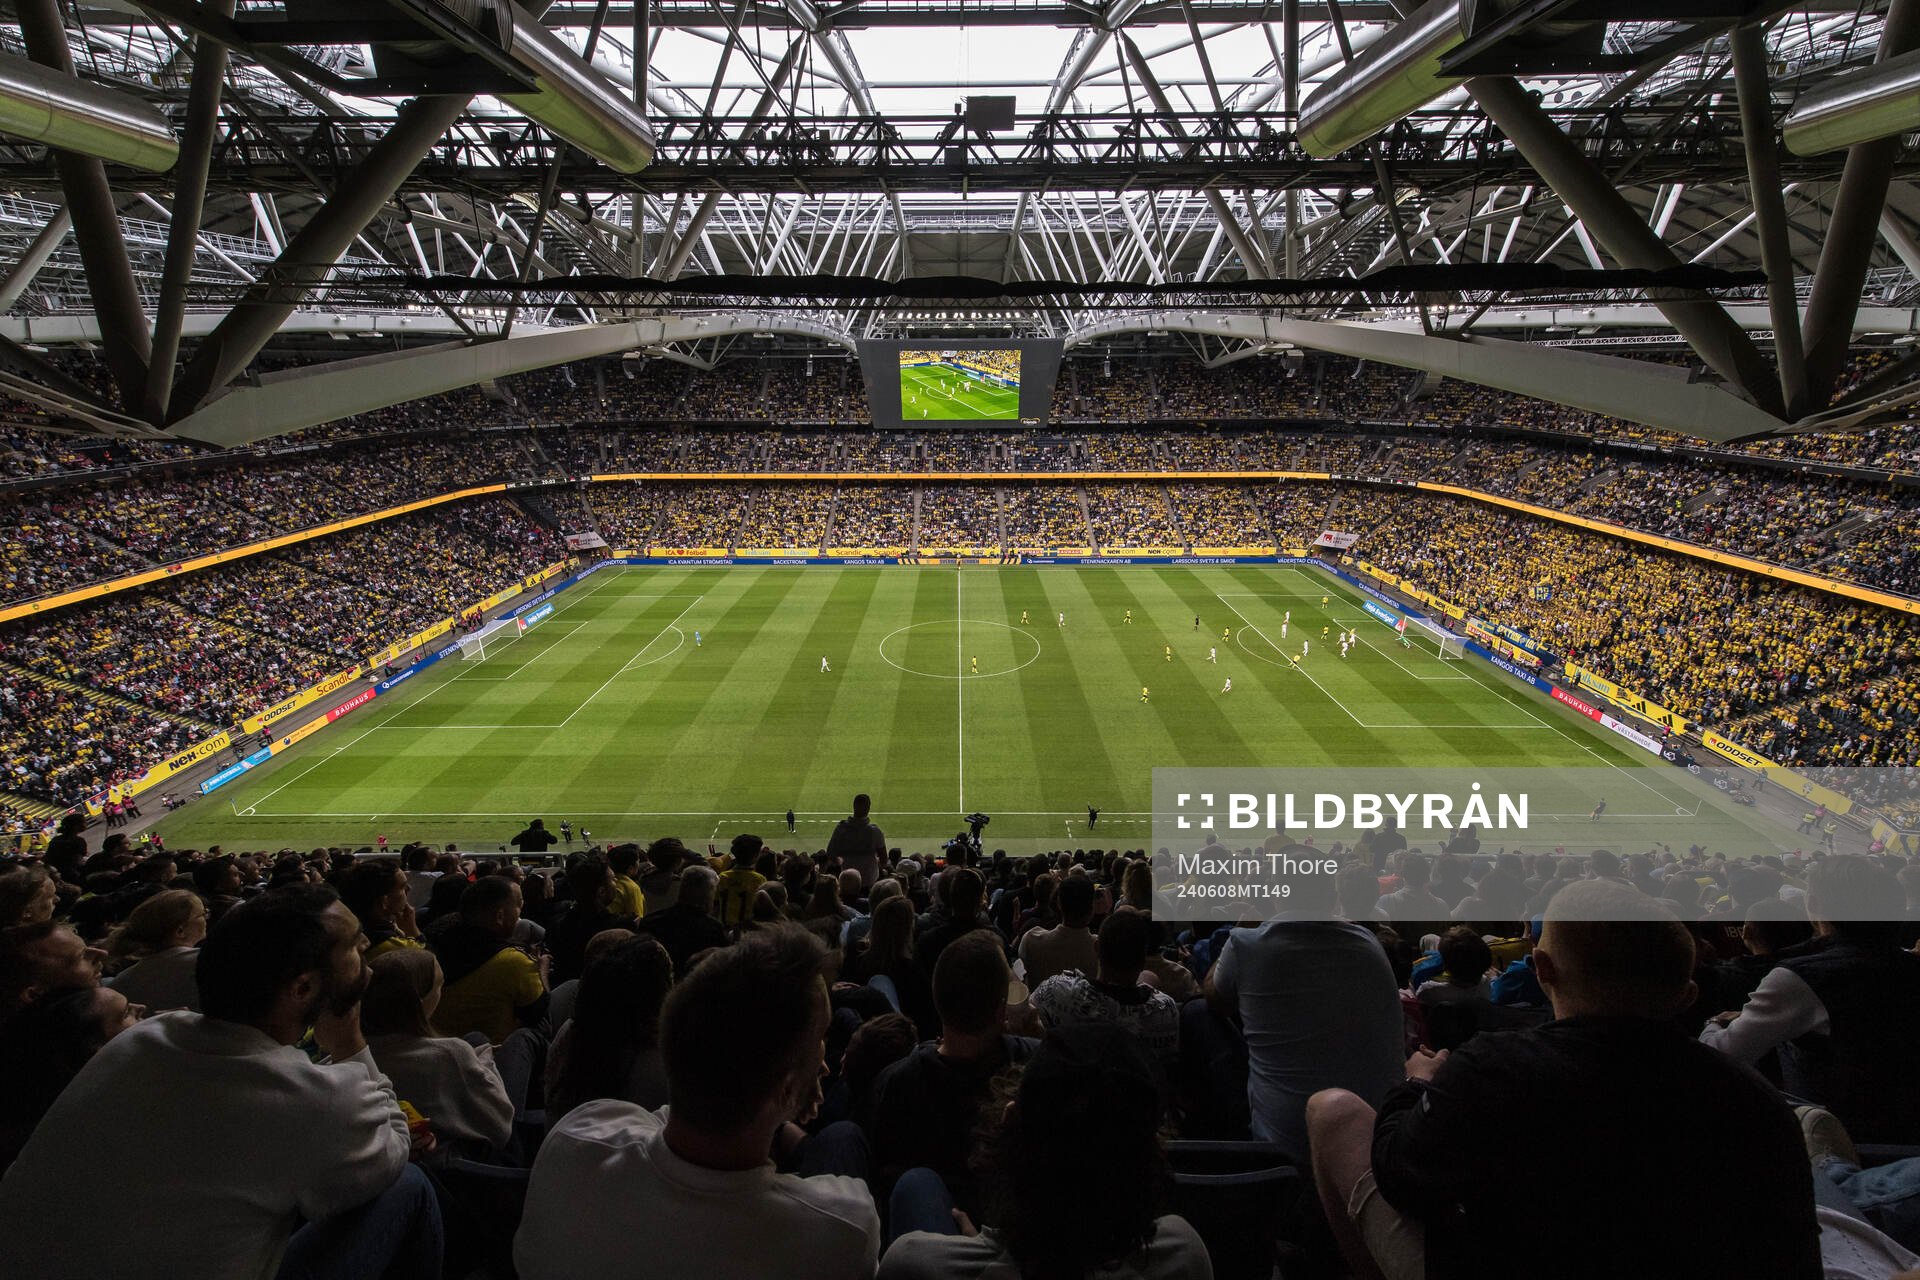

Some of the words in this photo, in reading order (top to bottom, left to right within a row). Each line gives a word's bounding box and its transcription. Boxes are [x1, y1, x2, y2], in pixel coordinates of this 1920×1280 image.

[1490, 655, 1513, 673] KANGOS
[1513, 668, 1526, 680] TAXI
[1526, 676, 1535, 685] AB
[316, 672, 353, 697] Scandic
[263, 700, 297, 722] ODDSET
[335, 693, 369, 716] BAUHAUS
[1558, 692, 1594, 716] BAUHAUS
[1716, 742, 1763, 767] ODDSET
